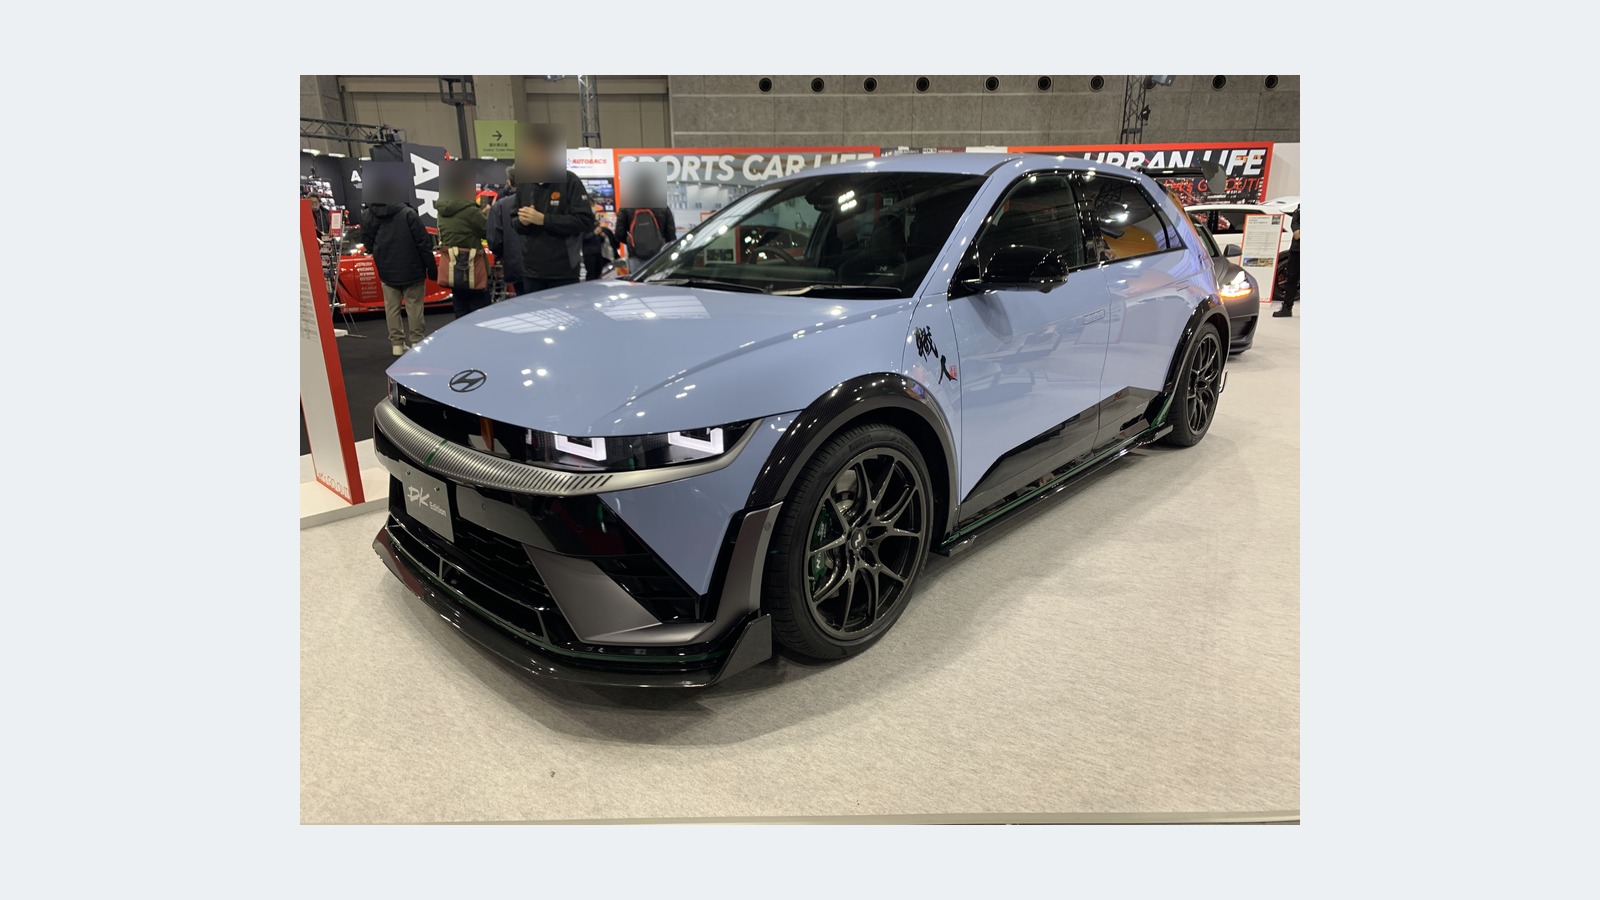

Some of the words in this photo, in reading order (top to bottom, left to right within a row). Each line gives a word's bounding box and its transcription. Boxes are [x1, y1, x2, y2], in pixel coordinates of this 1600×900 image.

[620, 154, 735, 181] ORTS
[742, 154, 804, 181] CAR
[407, 485, 430, 508] DK
[429, 501, 447, 518] Edition
